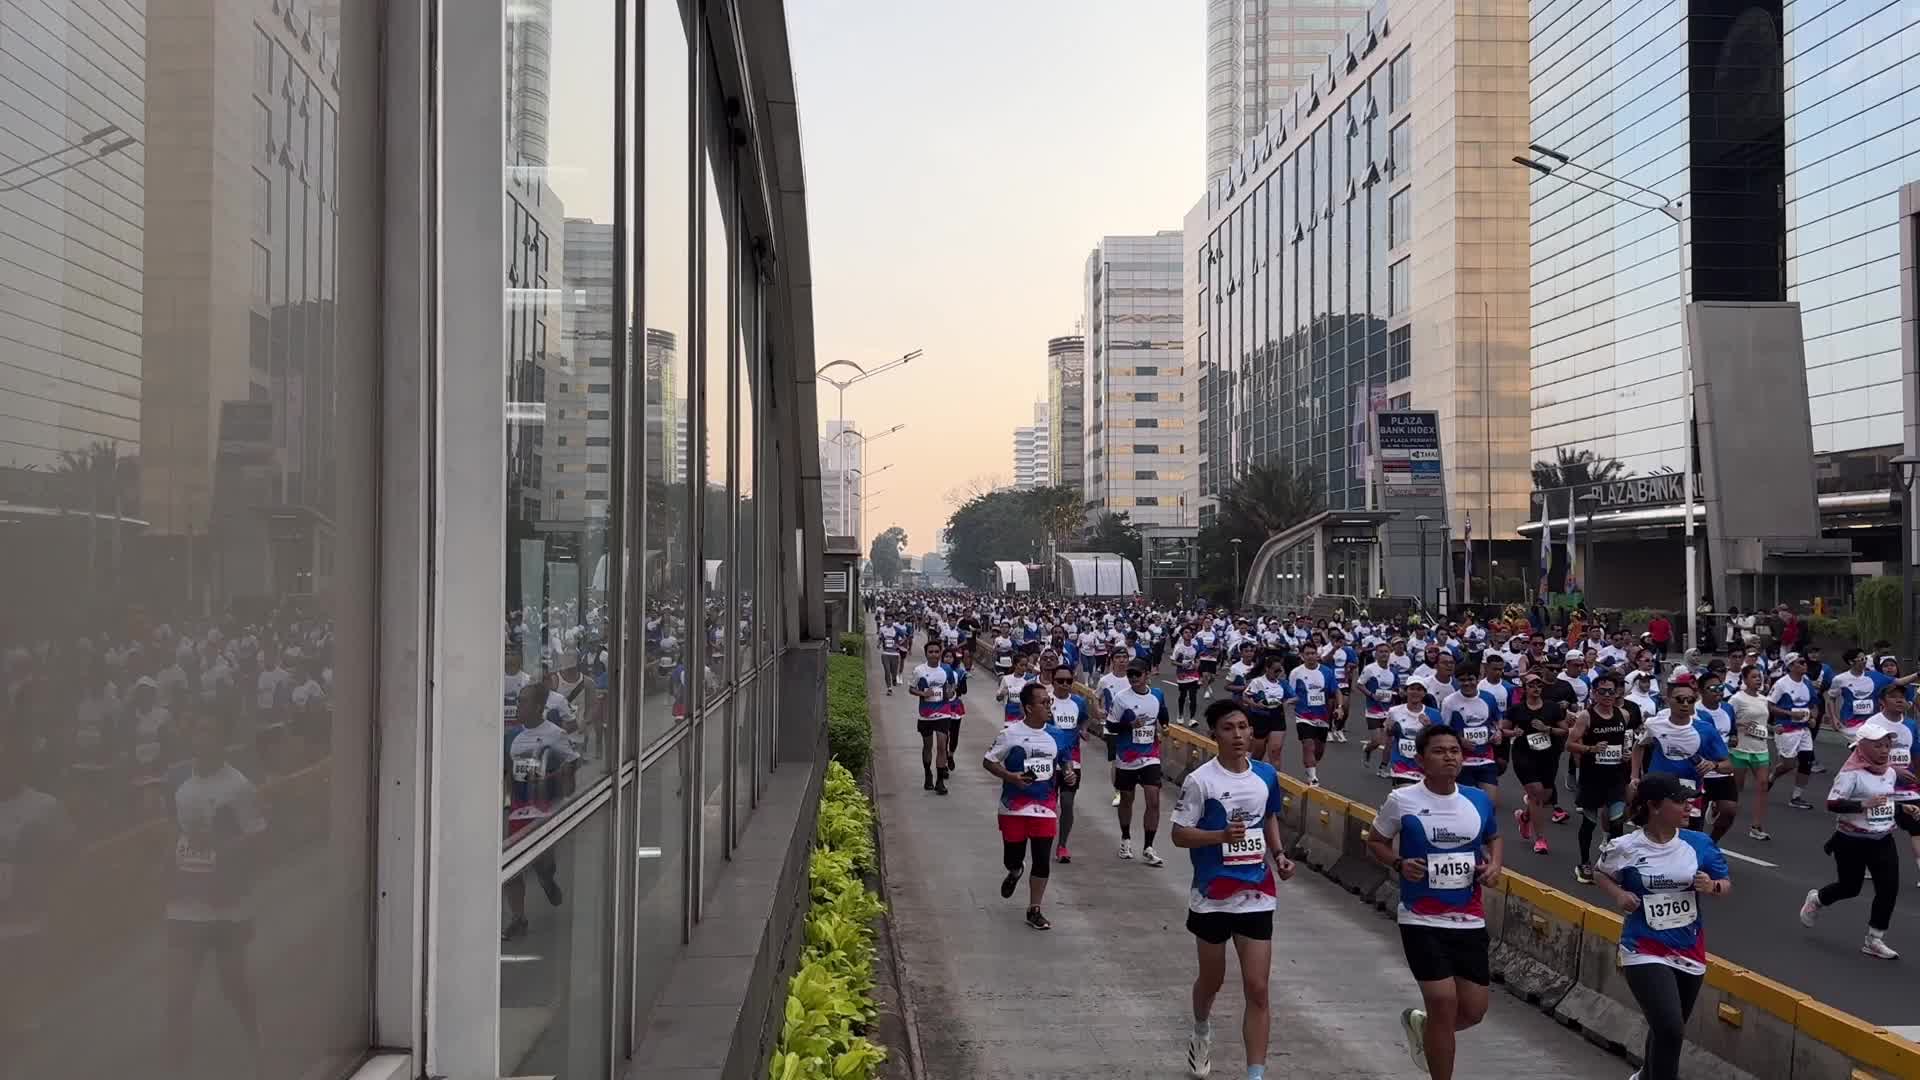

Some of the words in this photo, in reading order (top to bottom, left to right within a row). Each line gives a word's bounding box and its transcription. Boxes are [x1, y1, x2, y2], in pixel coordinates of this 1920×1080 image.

[1391, 416, 1424, 425] PLAZA
[1380, 426, 1406, 434] BANK
[1407, 426, 1435, 434] INDEX
[1591, 481, 1634, 505] PLAZA
[1638, 475, 1680, 502] BANK
[1593, 726, 1624, 734] GARMIN
[1228, 838, 1262, 853] 19935
[1434, 862, 1470, 876] 14159
[1649, 900, 1690, 918] 13760
